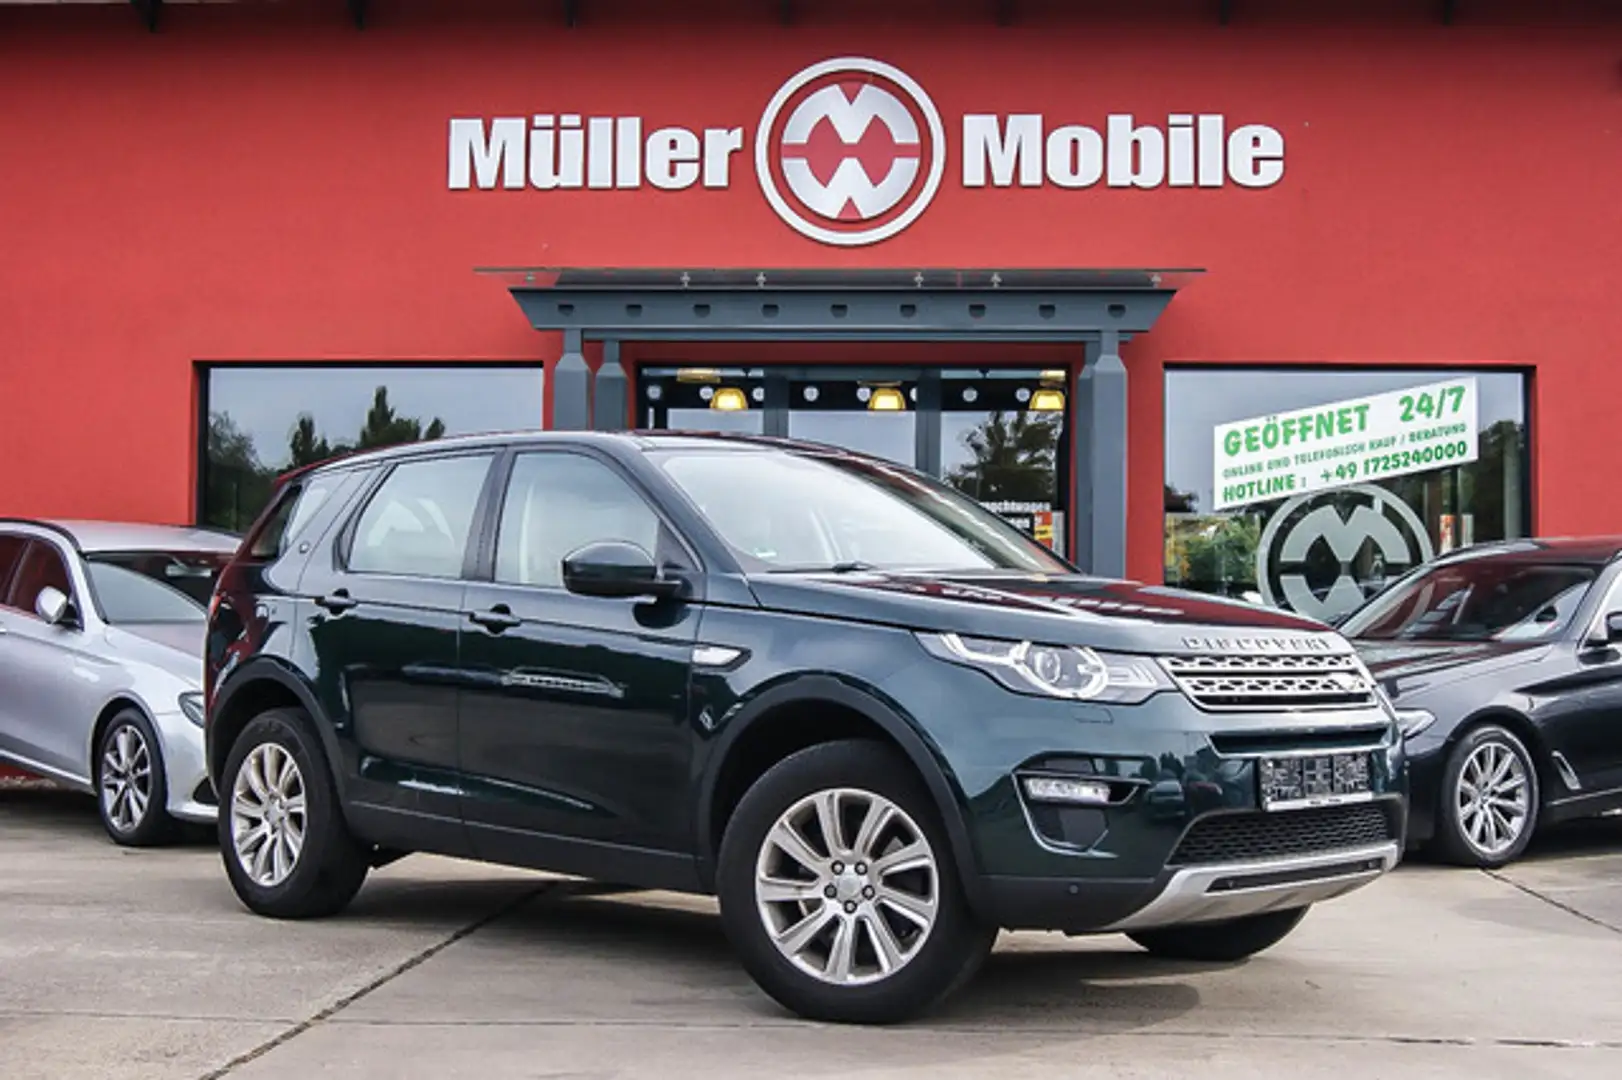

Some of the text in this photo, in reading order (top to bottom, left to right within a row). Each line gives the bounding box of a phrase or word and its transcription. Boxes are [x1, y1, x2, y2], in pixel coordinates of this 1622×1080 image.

[447, 113, 1285, 190] Müller Mobile
[1222, 462, 1263, 479] ONLINE
[1267, 457, 1291, 470] UND
[1294, 442, 1366, 465] TELEFONISCH
[1369, 436, 1397, 451] KAUF
[1409, 423, 1466, 443] BERATUNG
[1223, 385, 1466, 457] GEÖFFNET 24/7
[1223, 474, 1296, 503] HOTLINE
[1363, 440, 1468, 476] 1725240000
[1181, 636, 1331, 651] DISCOVERY
